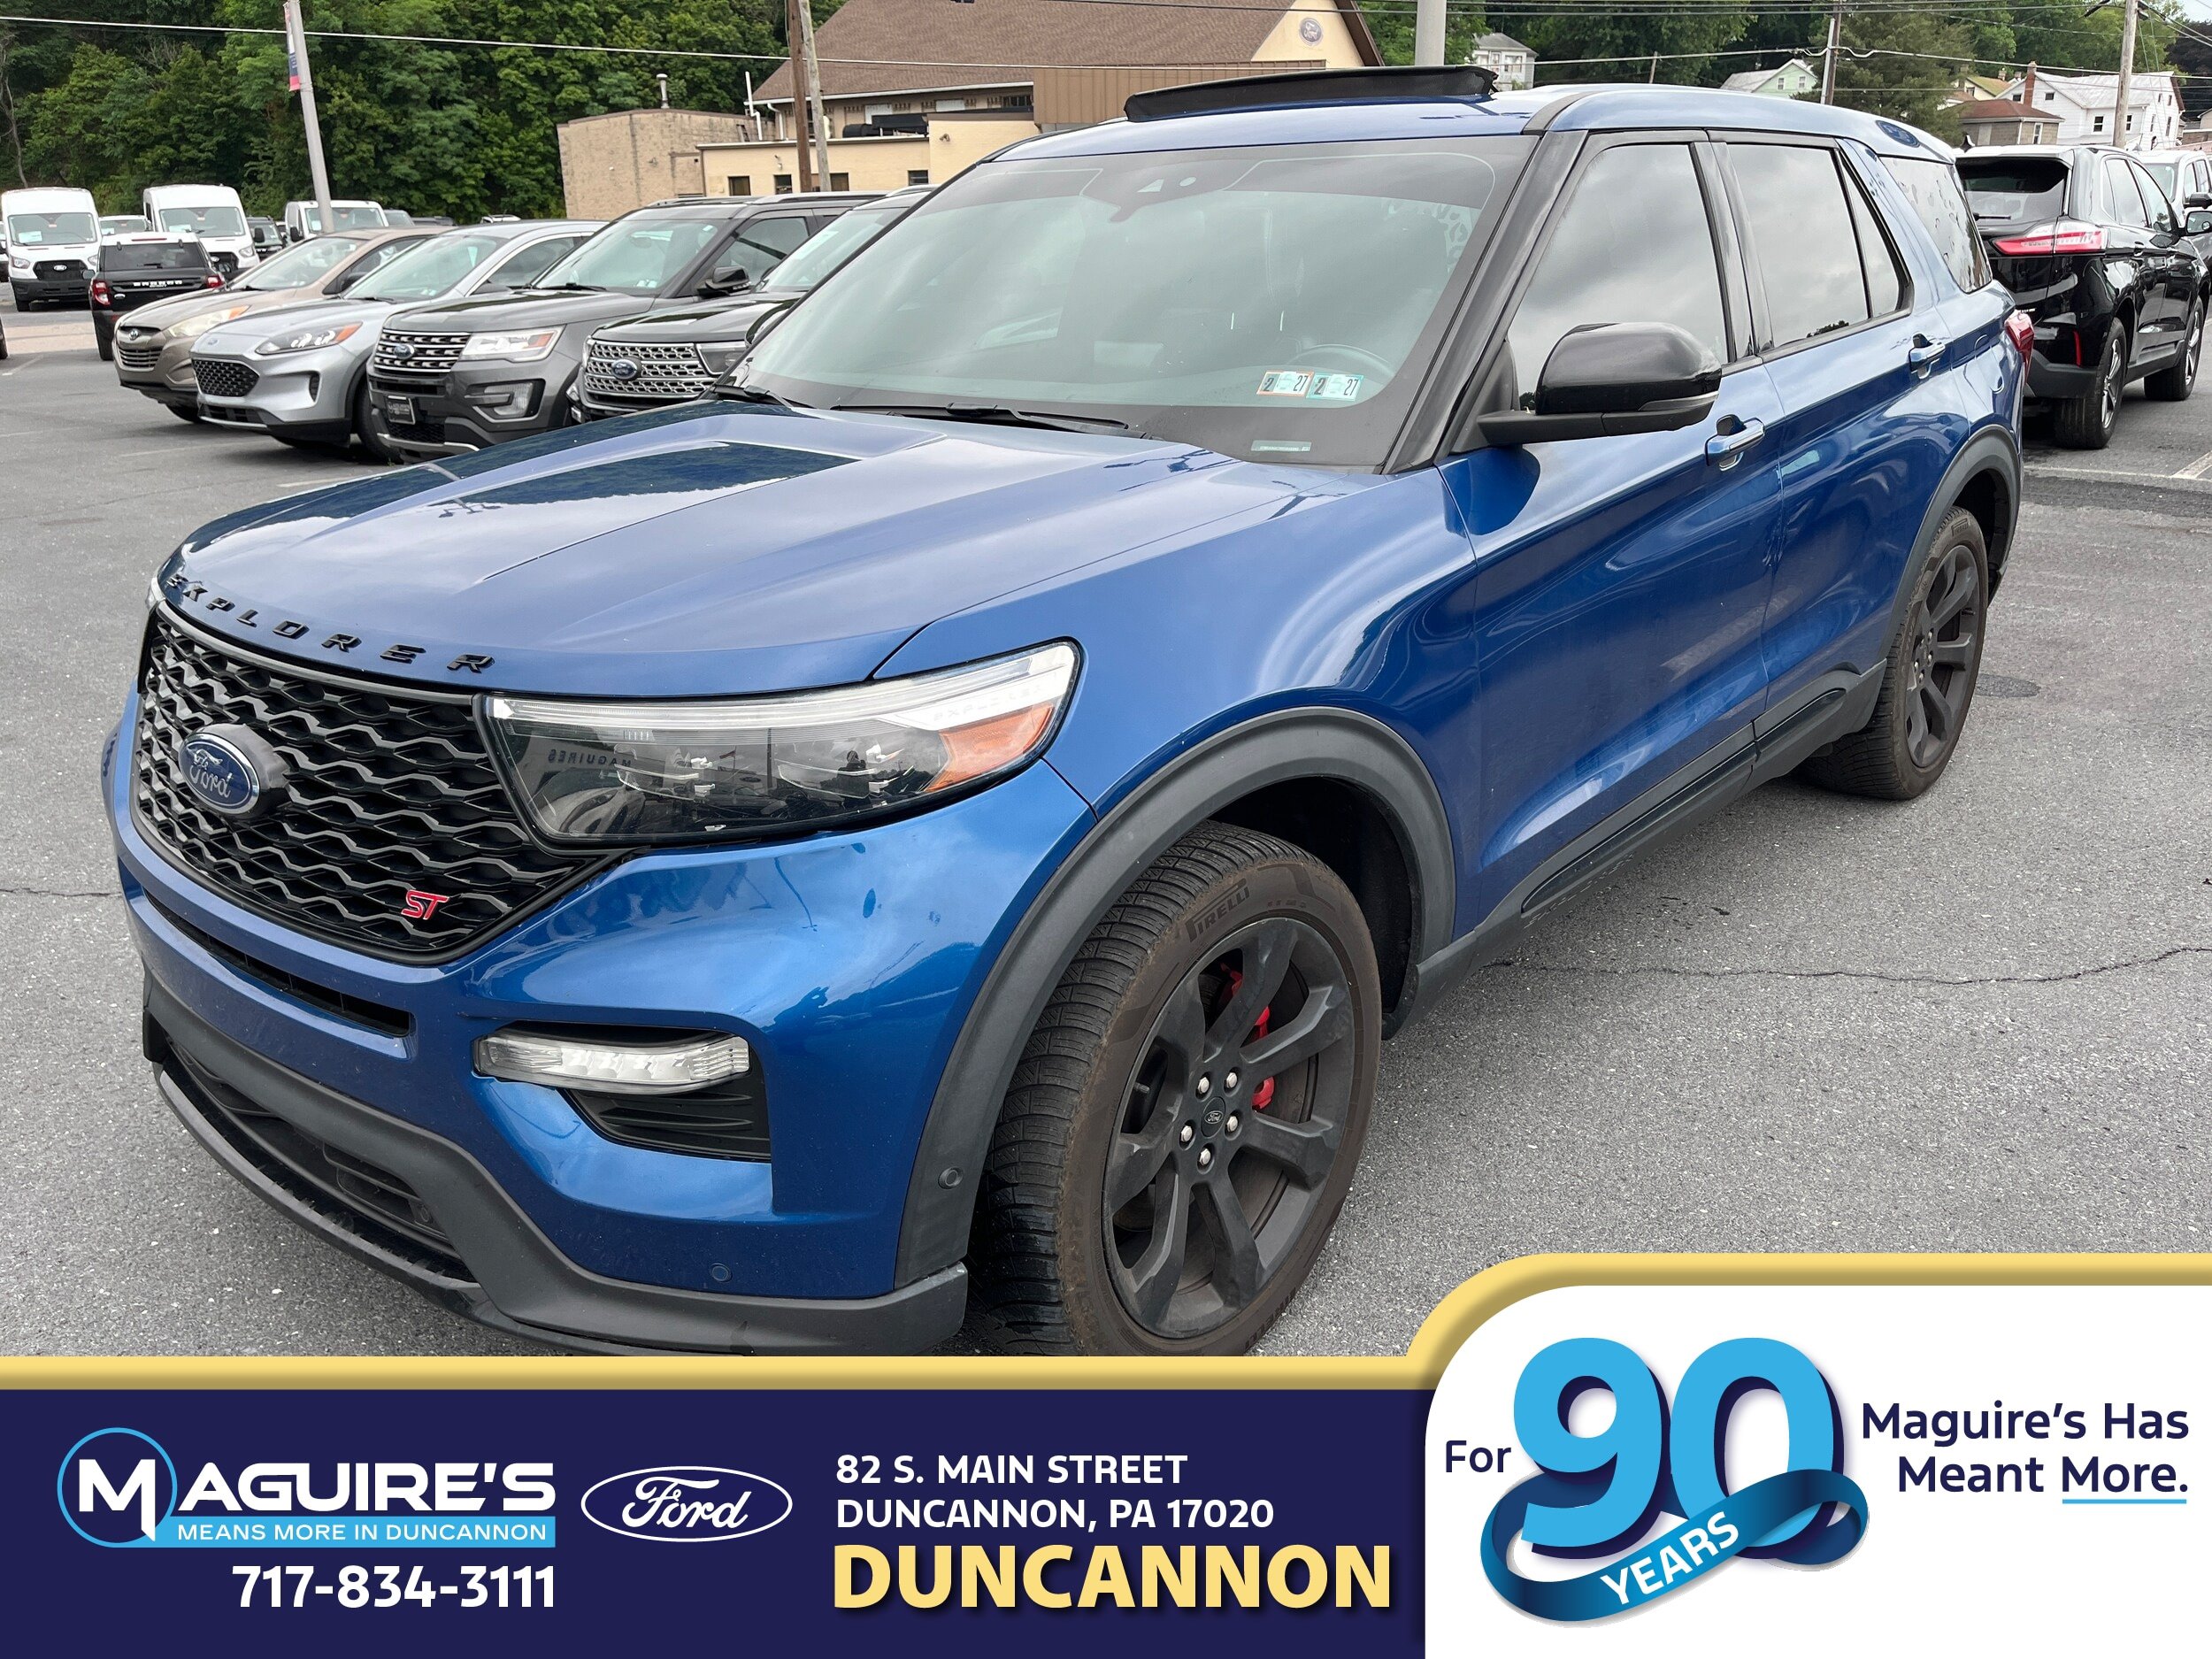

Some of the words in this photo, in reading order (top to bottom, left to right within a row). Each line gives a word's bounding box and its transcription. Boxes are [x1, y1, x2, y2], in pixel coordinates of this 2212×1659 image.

[1263, 377, 1274, 392] 2
[1293, 375, 1309, 392] 27
[1314, 378, 1325, 396] 2
[1344, 379, 1359, 396] 27
[165, 573, 495, 673] EXPLORER
[188, 747, 233, 799] Ford
[401, 889, 449, 920] ST
[1185, 878, 1250, 942] PIRELLI
